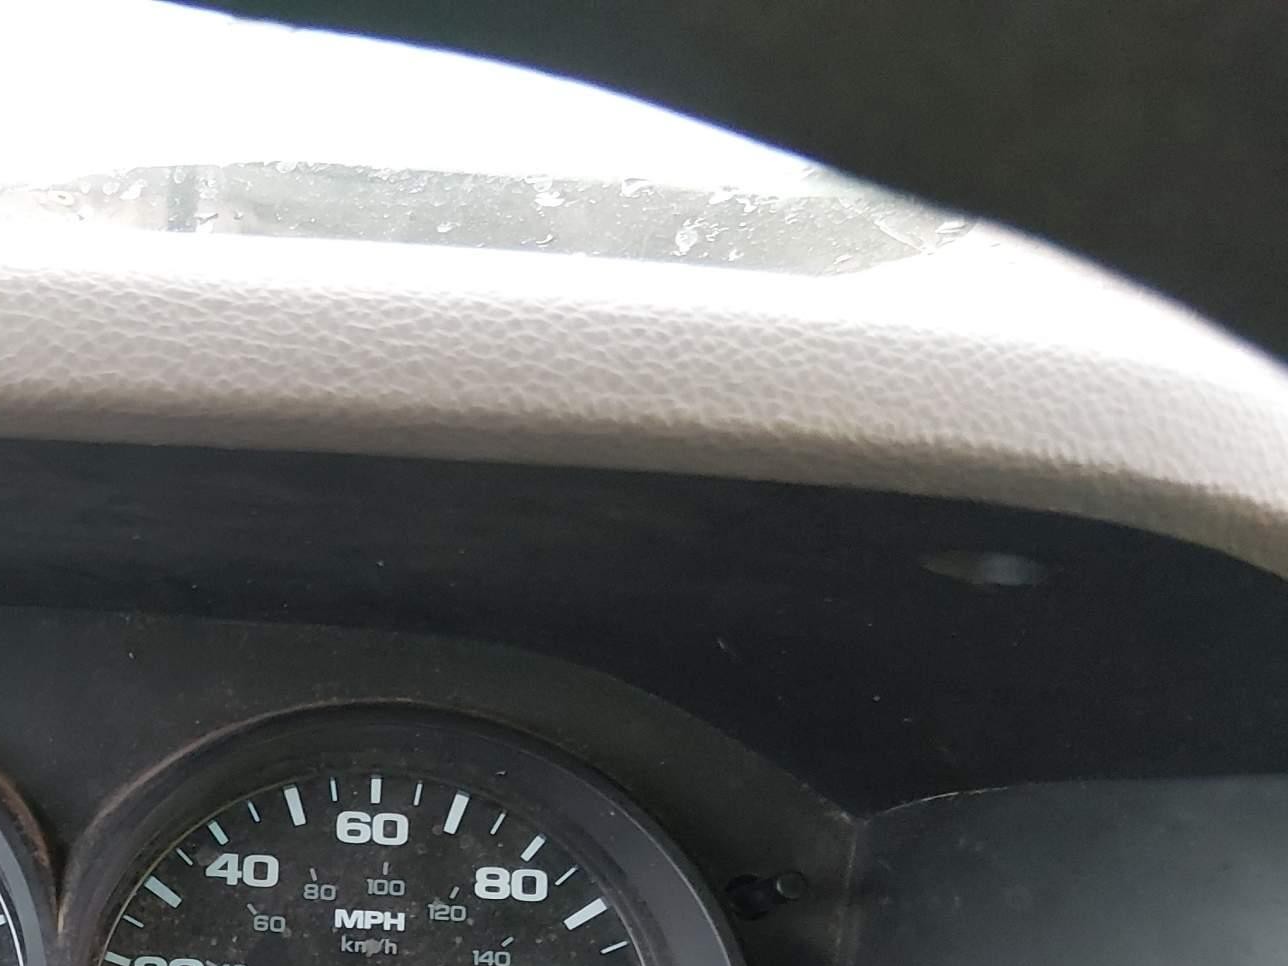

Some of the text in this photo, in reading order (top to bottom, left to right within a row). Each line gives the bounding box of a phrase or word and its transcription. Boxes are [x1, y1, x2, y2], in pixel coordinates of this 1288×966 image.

[336, 812, 409, 846] 60
[206, 854, 279, 887] 40
[303, 883, 337, 901] 80
[366, 879, 405, 896] 100
[474, 867, 548, 902] 80
[334, 908, 406, 932] MPH
[428, 903, 467, 922] 120
[252, 914, 286, 933] 60
